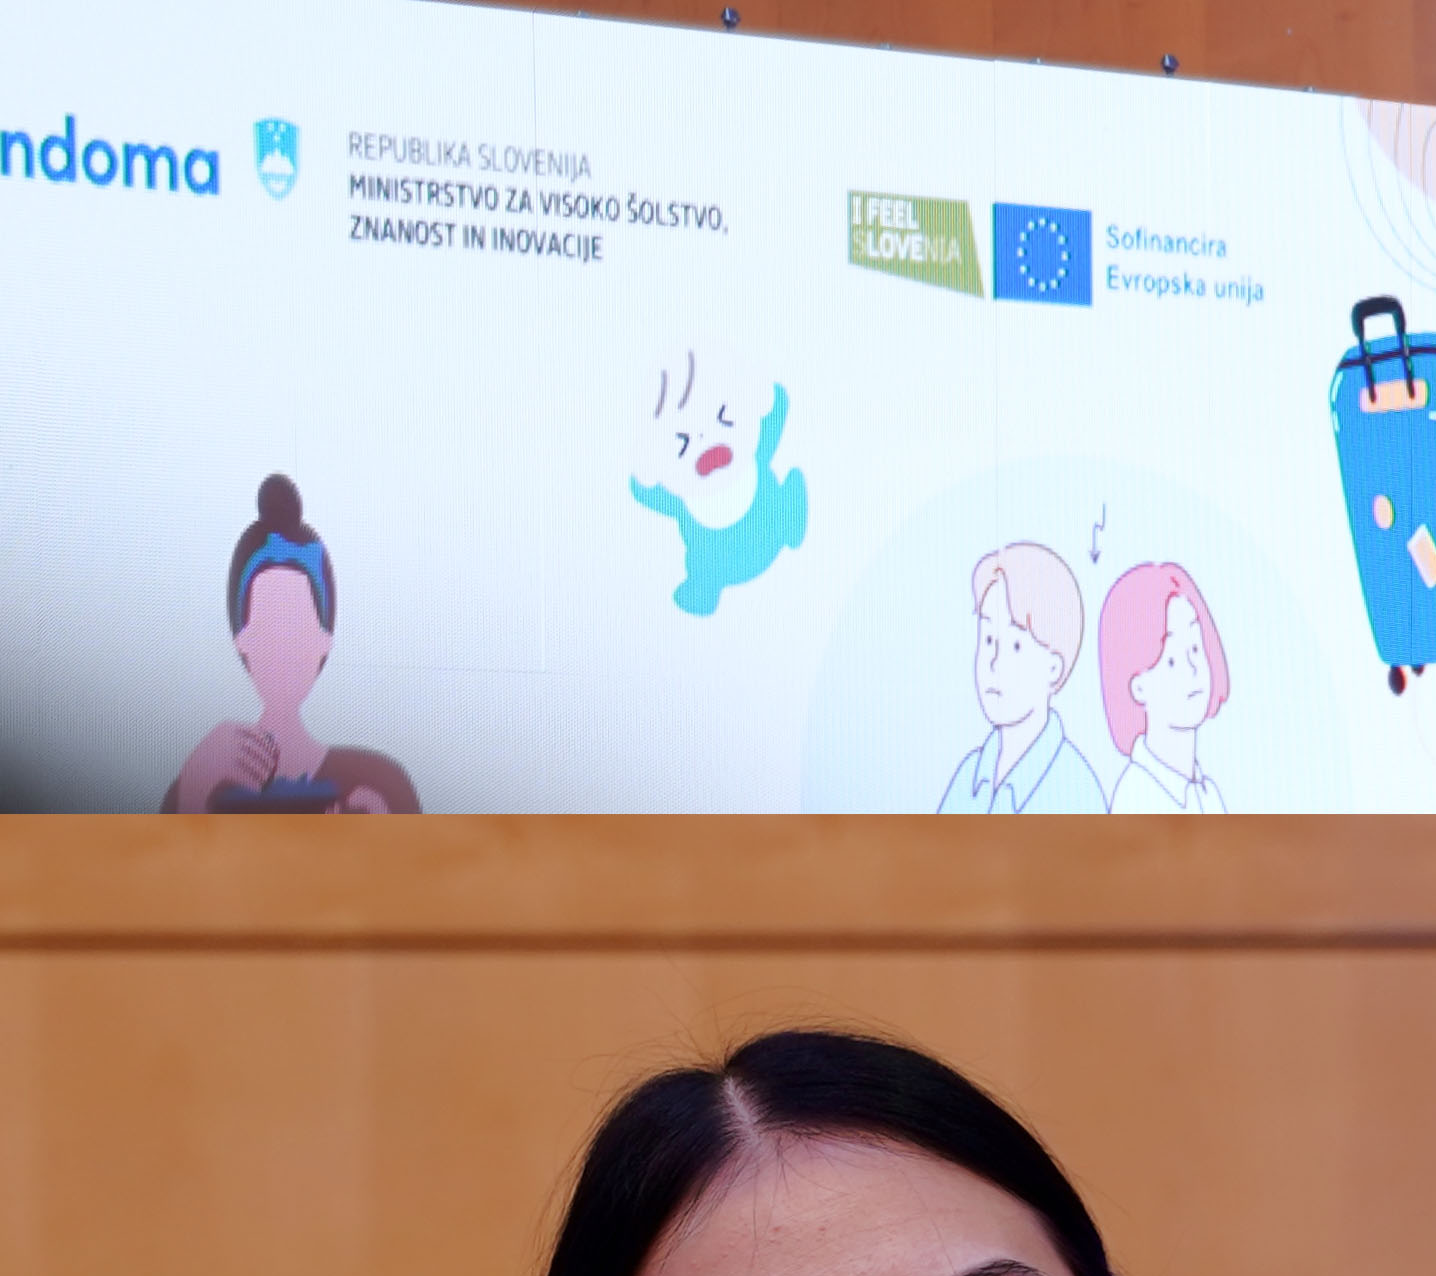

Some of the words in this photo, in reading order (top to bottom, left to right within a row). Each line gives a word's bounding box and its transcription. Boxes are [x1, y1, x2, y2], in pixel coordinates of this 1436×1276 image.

[0, 113, 219, 195] ndoma
[349, 131, 471, 168] REPUBLIKA
[478, 143, 592, 183] SLOVENIJA
[350, 174, 499, 211] MINISTRSTVO
[506, 187, 532, 214] ZA
[540, 190, 620, 222] VISOKO
[627, 192, 729, 234] ŠOLSTVO,
[852, 196, 862, 225] I
[866, 197, 919, 229] FEEL
[350, 215, 455, 248] ZNANOST
[463, 225, 485, 250] IN
[491, 227, 604, 263] INOVACIJE
[852, 229, 963, 265] SLOVENIA
[1106, 224, 1227, 258] Sofinancira
[1106, 264, 1206, 299] Evropska
[1215, 275, 1264, 307] unija
